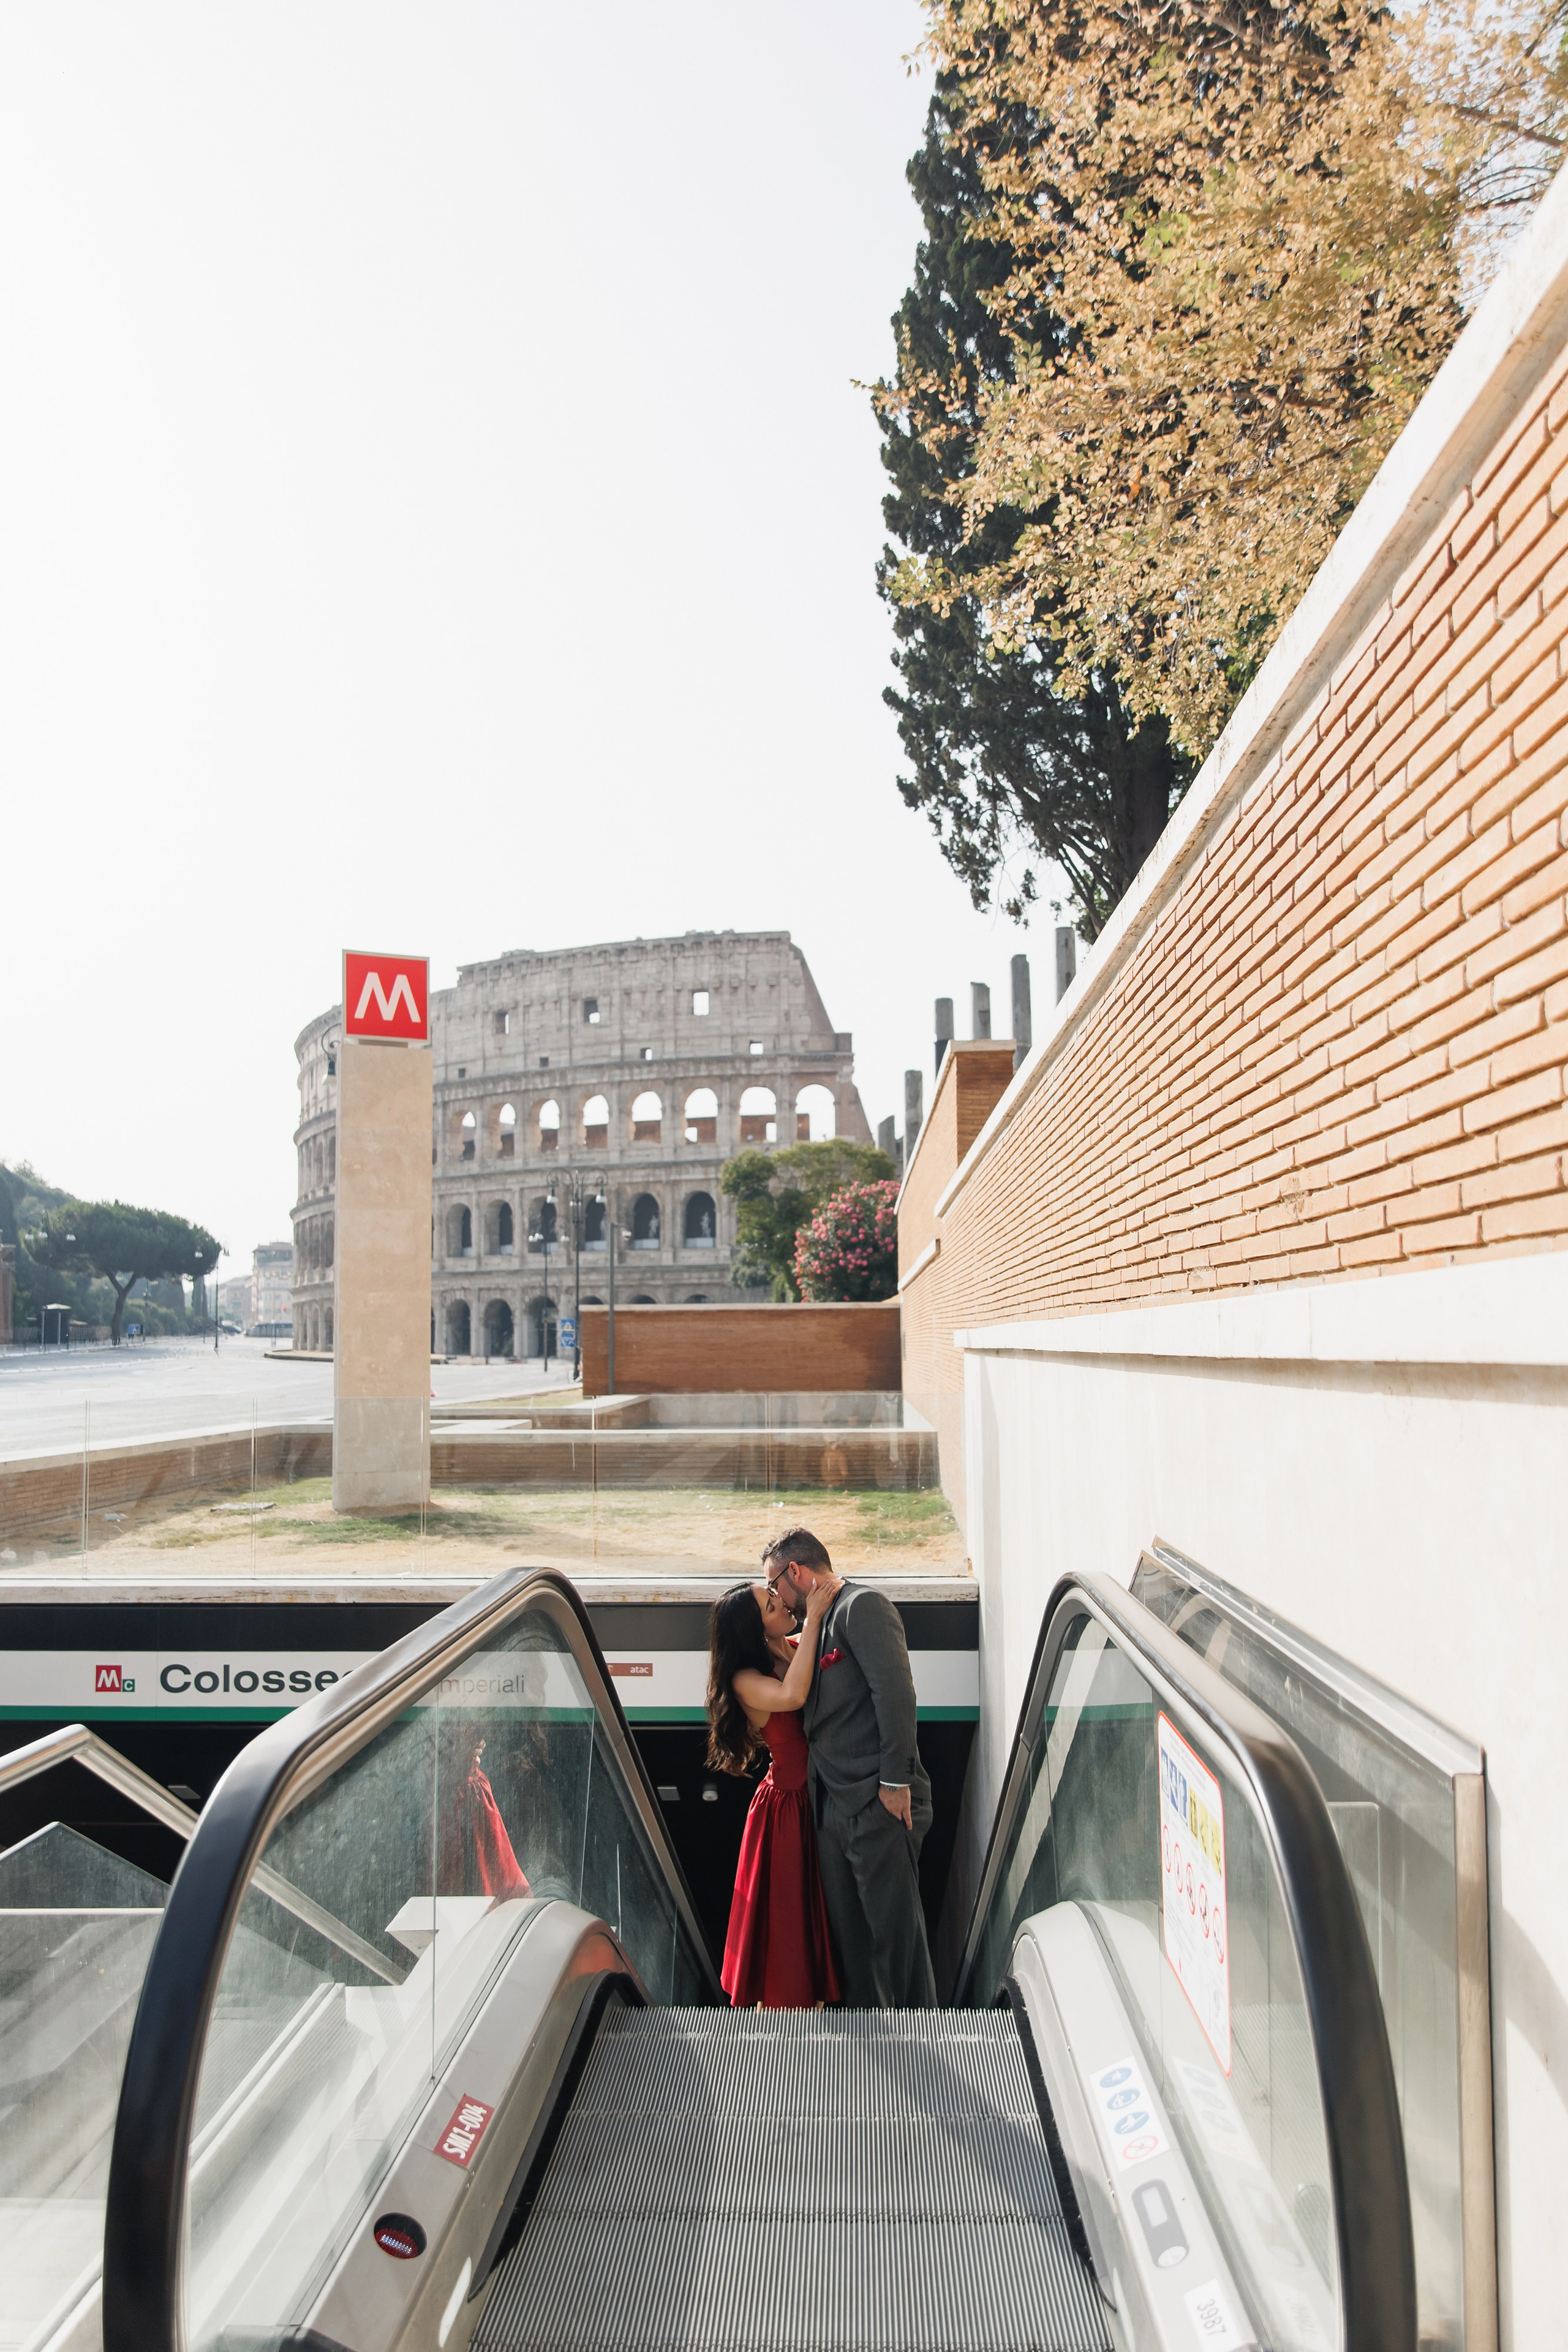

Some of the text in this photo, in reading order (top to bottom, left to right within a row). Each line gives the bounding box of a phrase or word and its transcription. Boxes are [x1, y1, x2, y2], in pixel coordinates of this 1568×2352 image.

[354, 971, 421, 1023] M
[97, 1669, 120, 1688] M
[160, 1664, 354, 1693] Colosse
[442, 2103, 488, 2160] SM1-004
[1197, 2298, 1227, 2336] 3987
